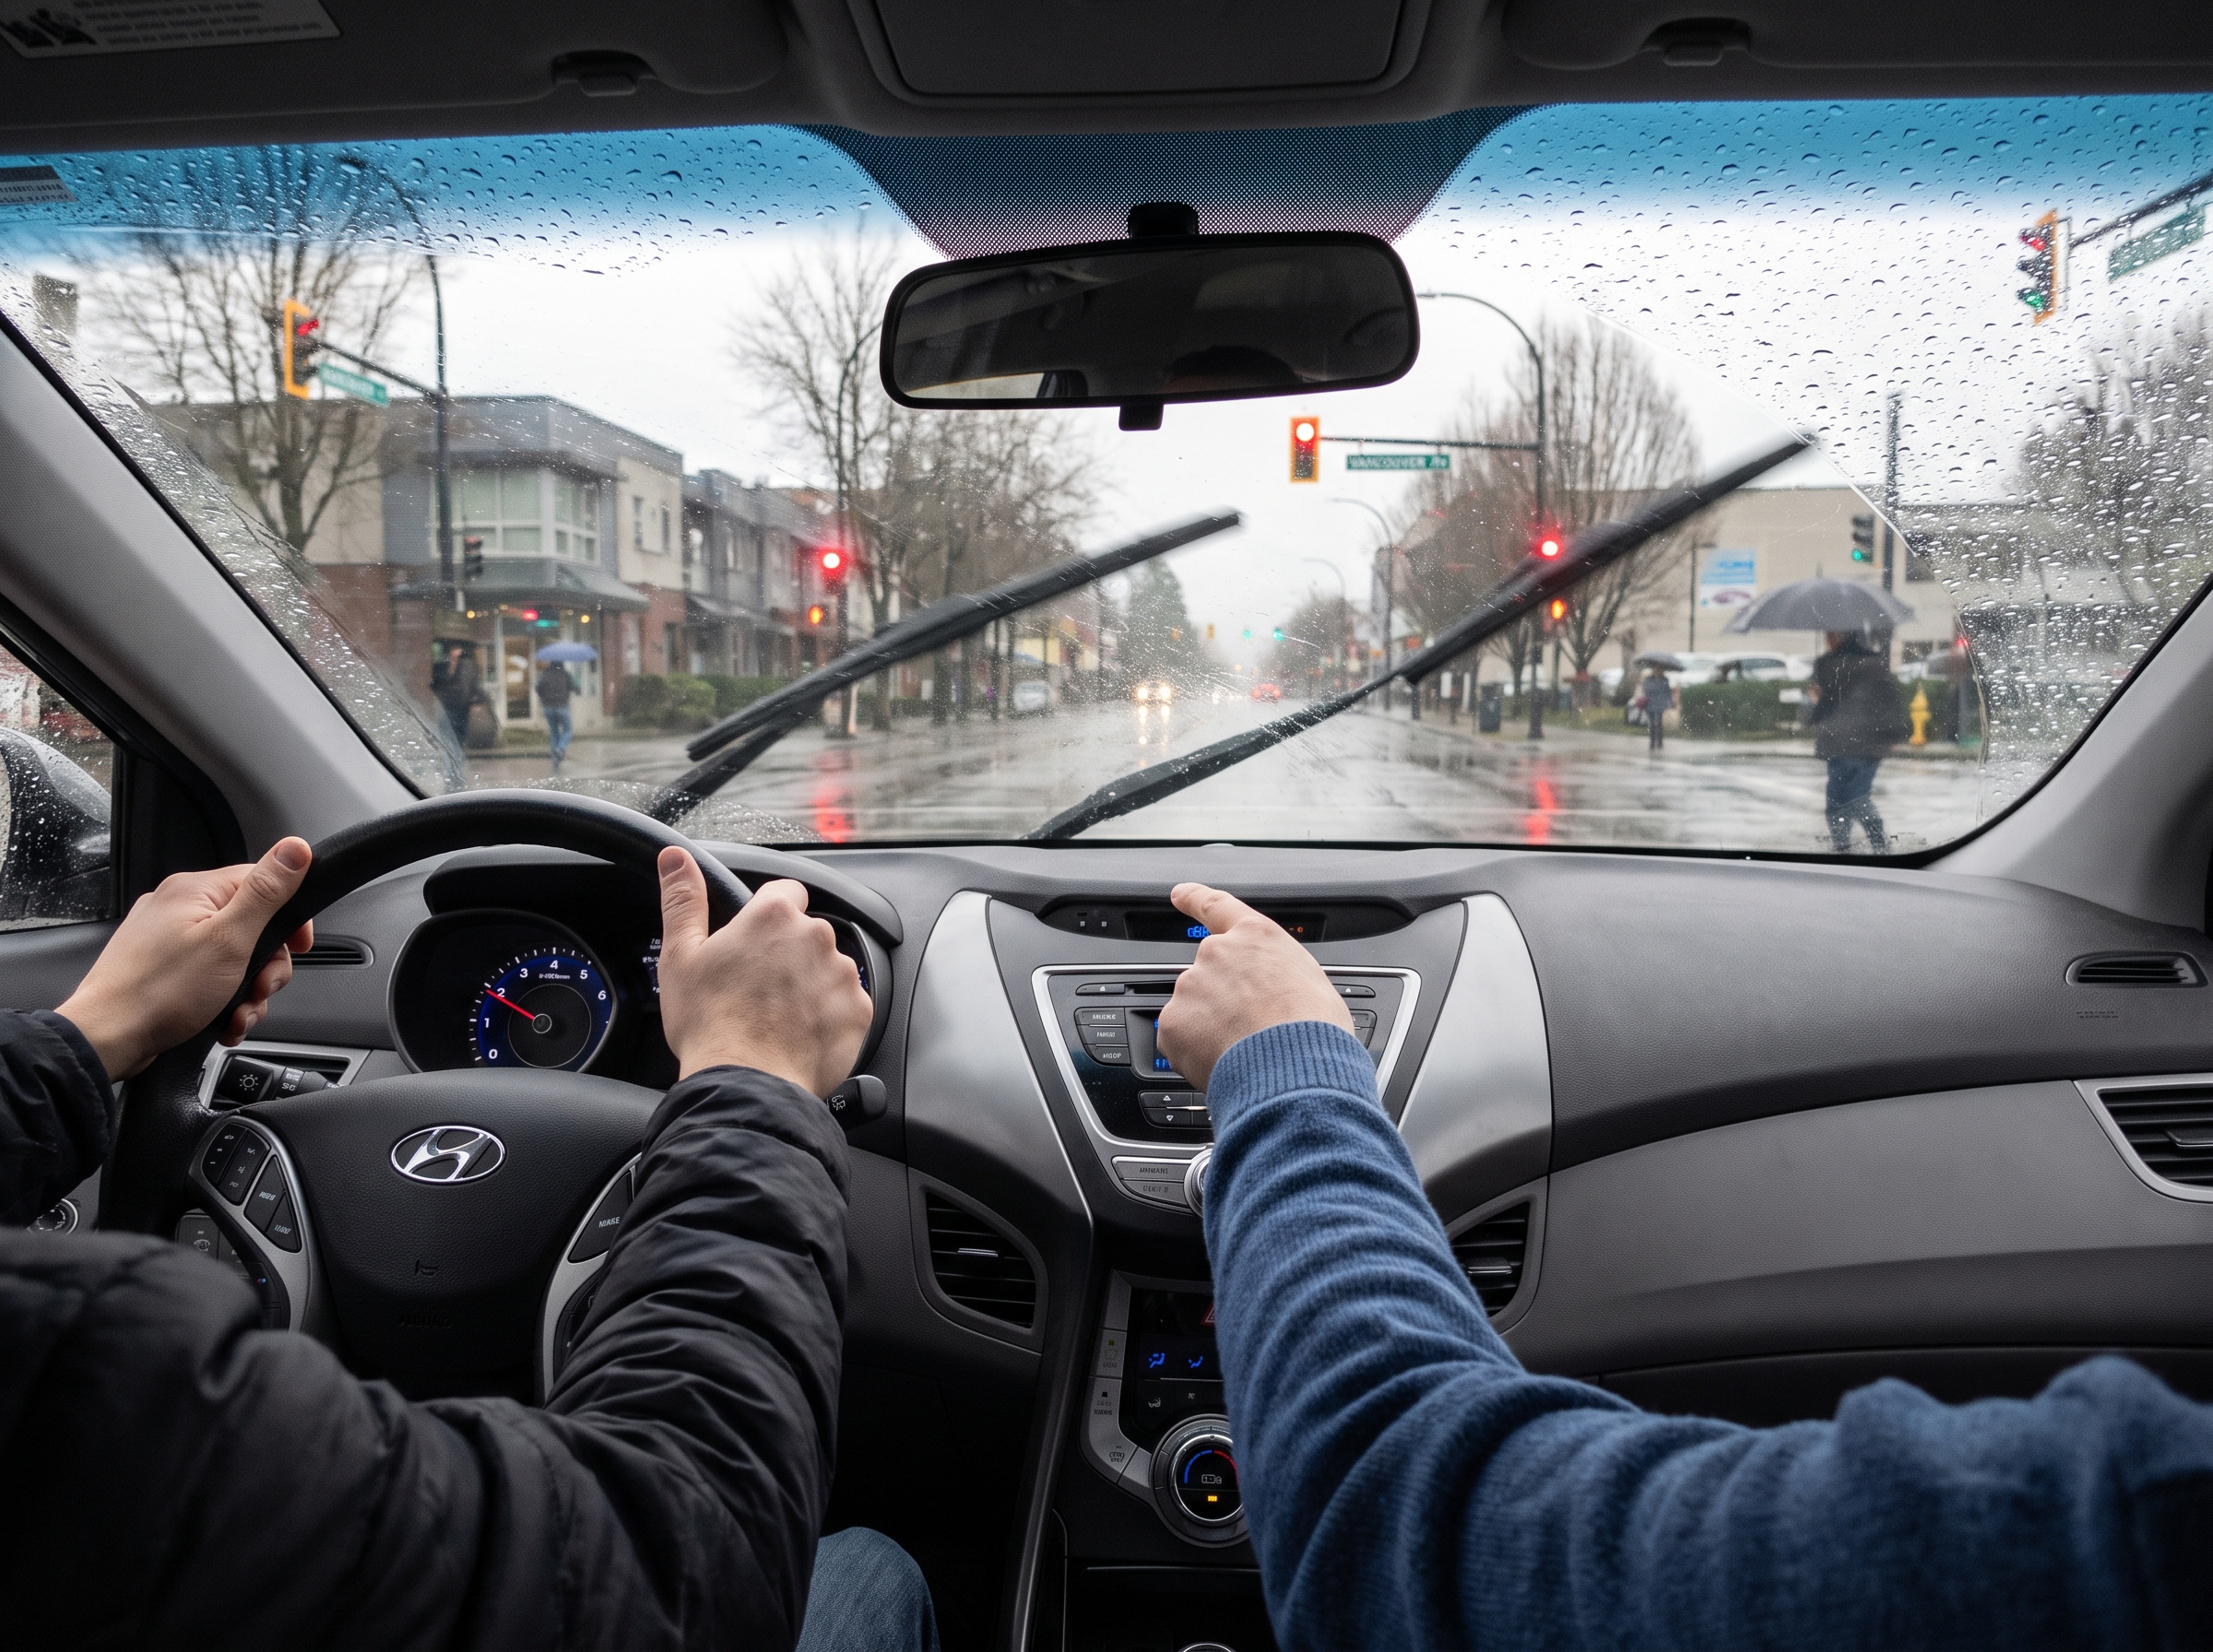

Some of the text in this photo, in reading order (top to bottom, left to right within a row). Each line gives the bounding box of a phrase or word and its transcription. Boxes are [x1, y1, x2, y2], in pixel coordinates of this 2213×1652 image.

[550, 960, 559, 970] 4
[519, 968, 528, 978] 3
[579, 969, 588, 980] 5
[497, 987, 505, 998] 2
[598, 990, 607, 1000] 6
[484, 1018, 490, 1028] 1
[488, 1049, 498, 1059] 0
